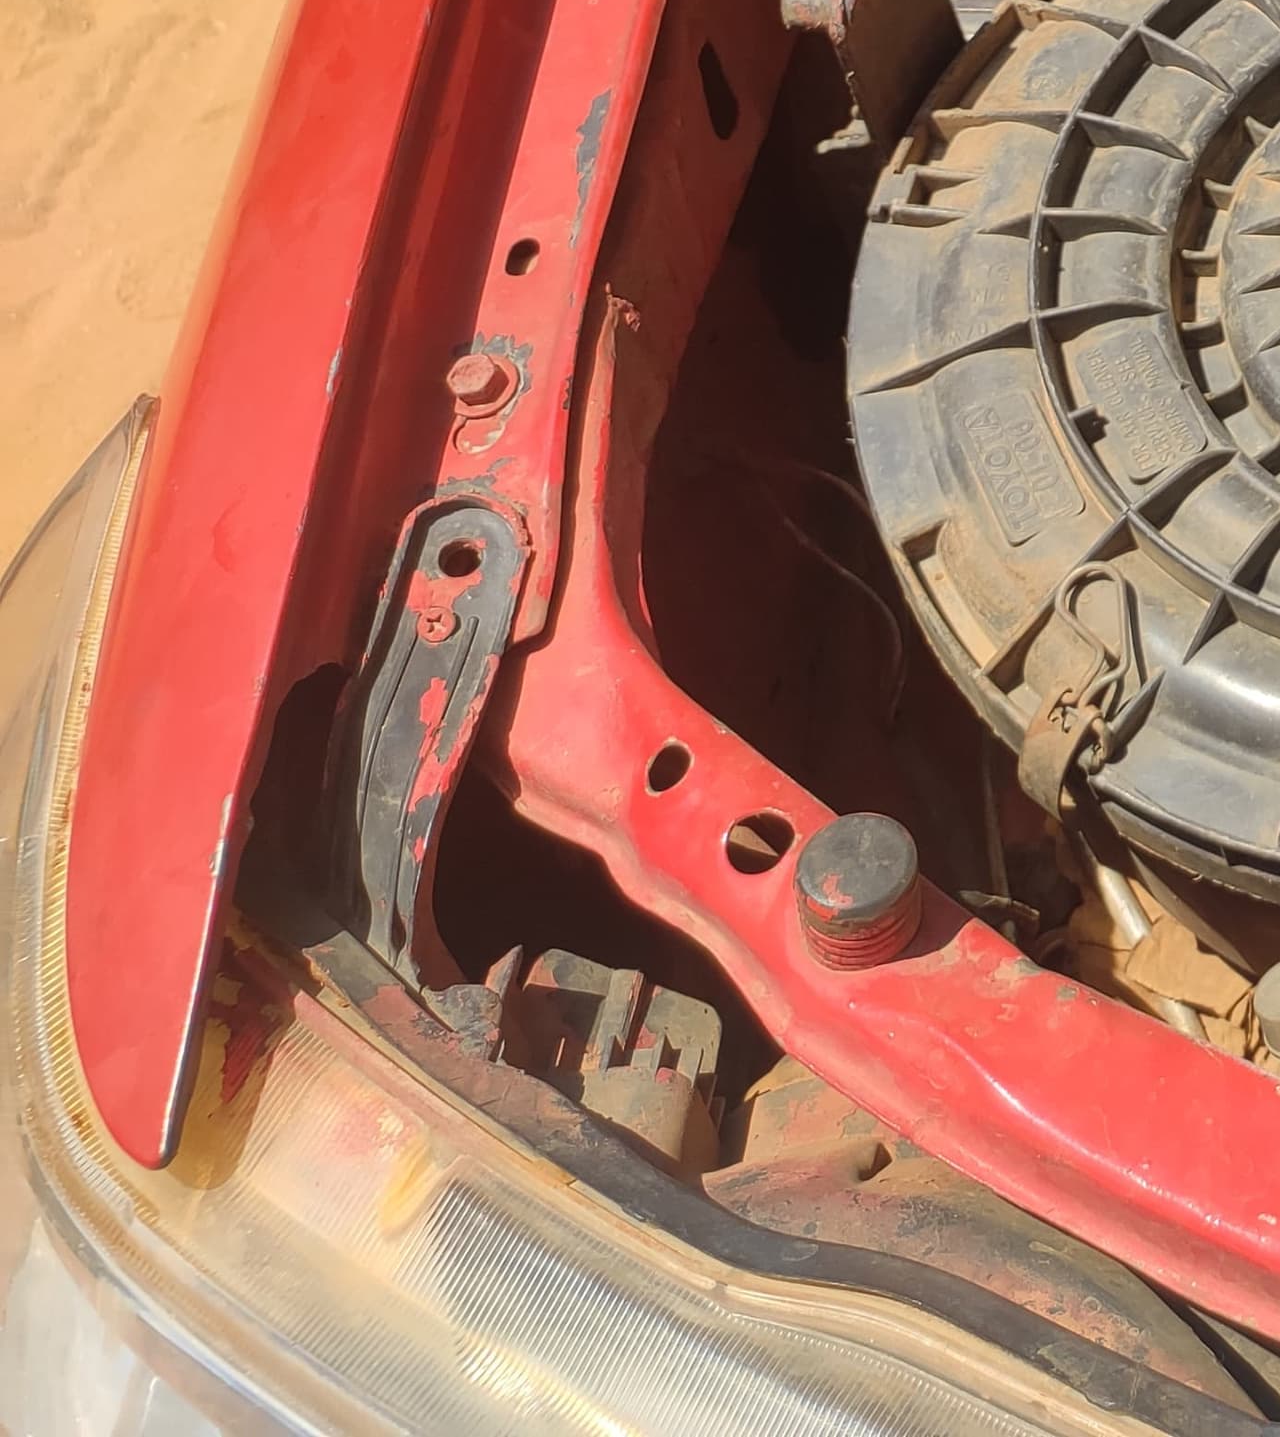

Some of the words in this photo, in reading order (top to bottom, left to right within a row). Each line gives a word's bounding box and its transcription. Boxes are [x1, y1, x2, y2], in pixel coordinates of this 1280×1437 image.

[1087, 347, 1124, 407] CLEANER
[1116, 411, 1138, 439] AIR
[957, 406, 1041, 531] TOYOTA
[1131, 442, 1153, 471] FOR
